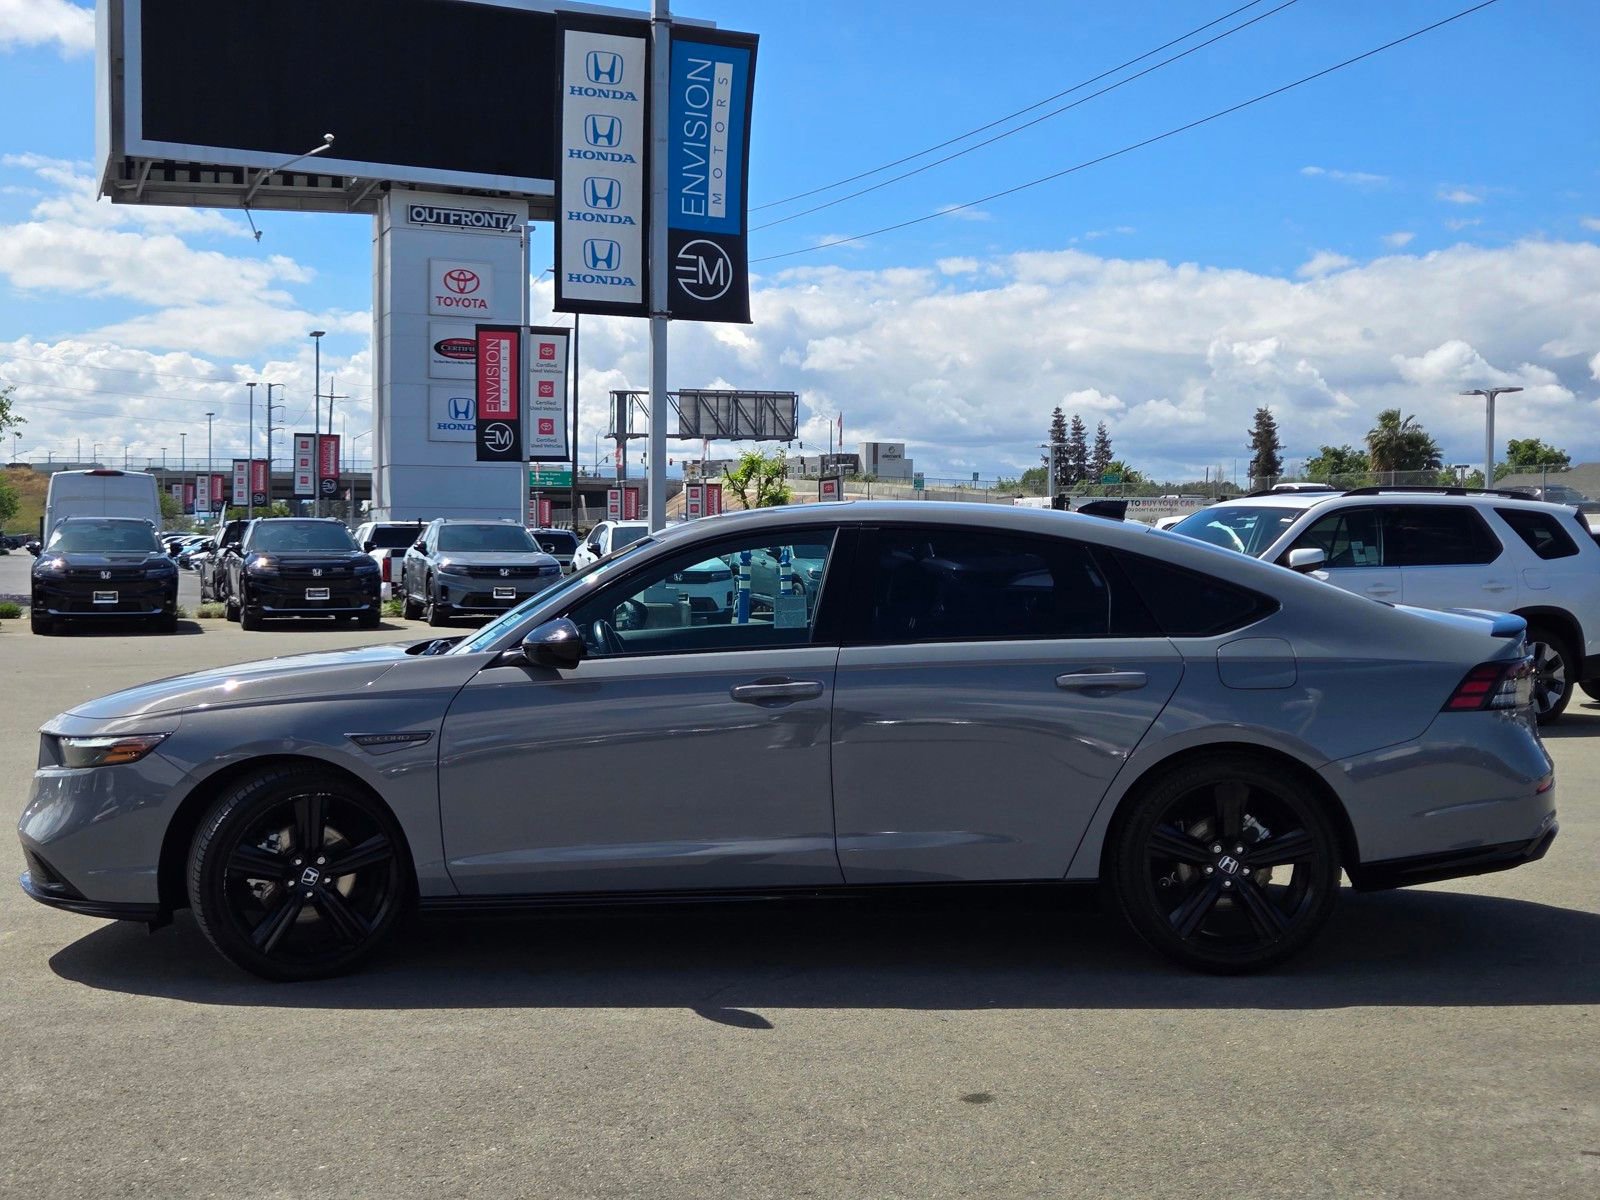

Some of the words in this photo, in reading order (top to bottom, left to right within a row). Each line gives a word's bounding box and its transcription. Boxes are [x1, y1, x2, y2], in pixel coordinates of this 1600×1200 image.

[569, 85, 638, 102] HONDA
[682, 58, 712, 217] ENVISION
[712, 77, 729, 205] MOTORS
[568, 149, 636, 164] HONDA
[567, 211, 636, 226] HONDA
[567, 273, 636, 287] HONDA
[436, 296, 488, 309] TOYOTA
[486, 338, 500, 412] ENVISION
[437, 422, 476, 431] HOND
